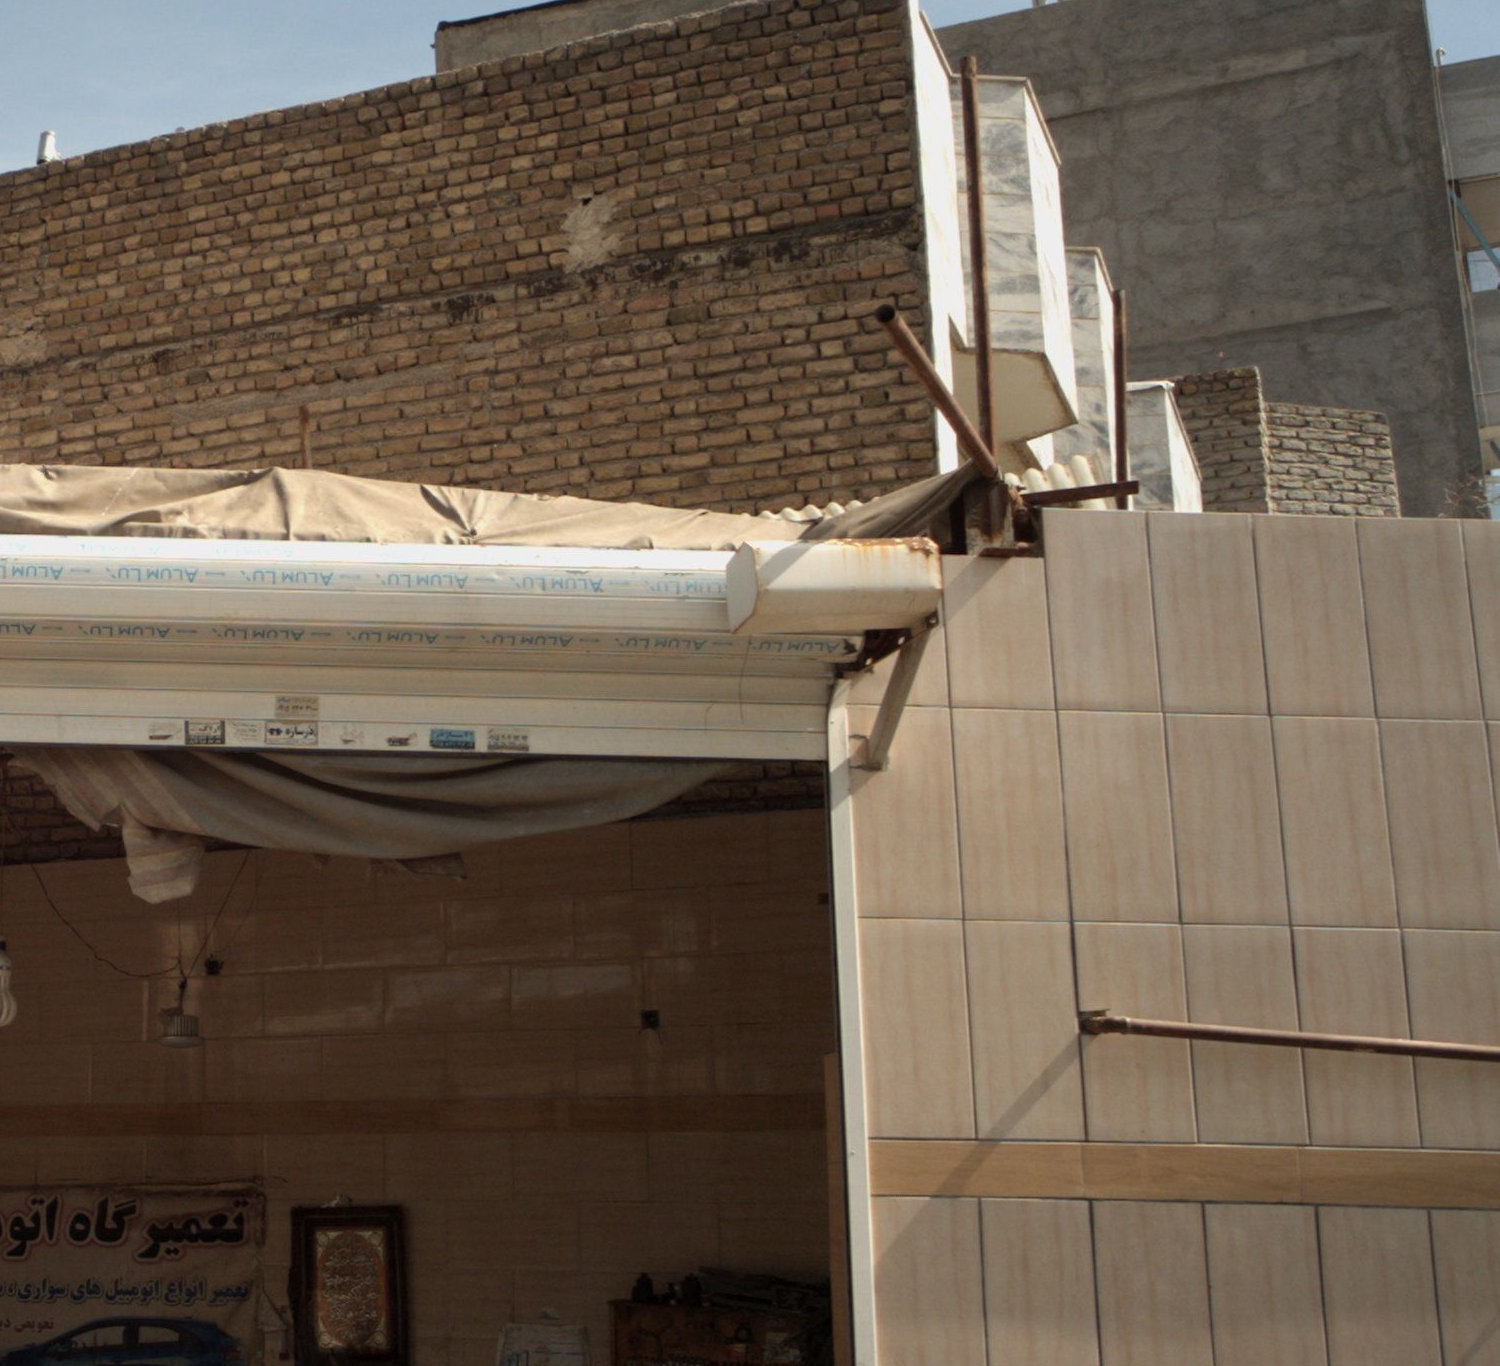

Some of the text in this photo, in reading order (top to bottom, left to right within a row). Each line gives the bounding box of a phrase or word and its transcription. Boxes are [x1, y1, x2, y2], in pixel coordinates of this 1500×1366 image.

[68, 1196, 137, 1242] گاه
[138, 1198, 249, 1259] تعمیر
[70, 1277, 101, 1301] های
[105, 1277, 160, 1303] اتومبیل
[163, 1276, 205, 1304] انواع
[209, 1279, 253, 1305] تعمیر
